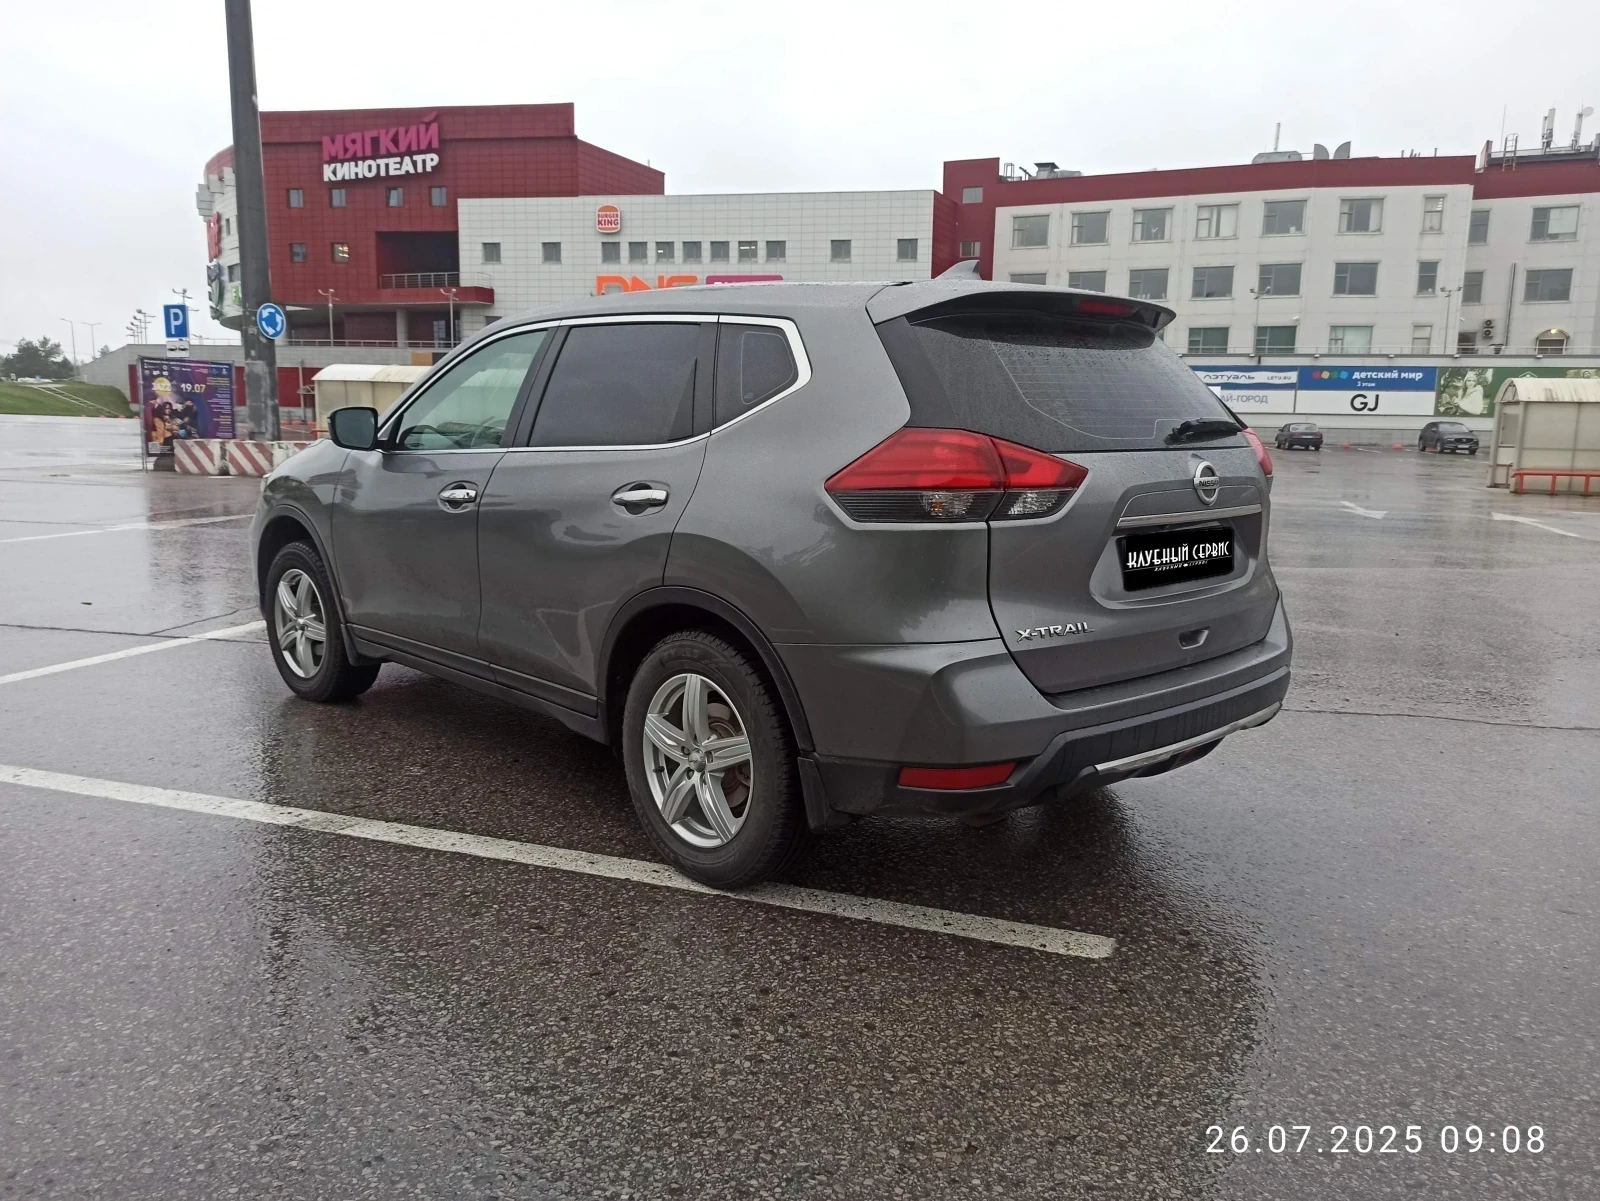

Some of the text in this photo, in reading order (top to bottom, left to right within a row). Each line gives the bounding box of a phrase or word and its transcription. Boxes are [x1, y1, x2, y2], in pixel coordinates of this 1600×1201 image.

[321, 111, 440, 161] МЯГКИЙ
[323, 153, 440, 182] КИНОТЕАТР
[597, 219, 619, 227] KING
[169, 308, 184, 335] P
[1352, 370, 1423, 381] детский мир
[180, 383, 206, 393] 19.07
[1350, 393, 1380, 412] GJ
[1015, 622, 1095, 642] X-TRAIL
